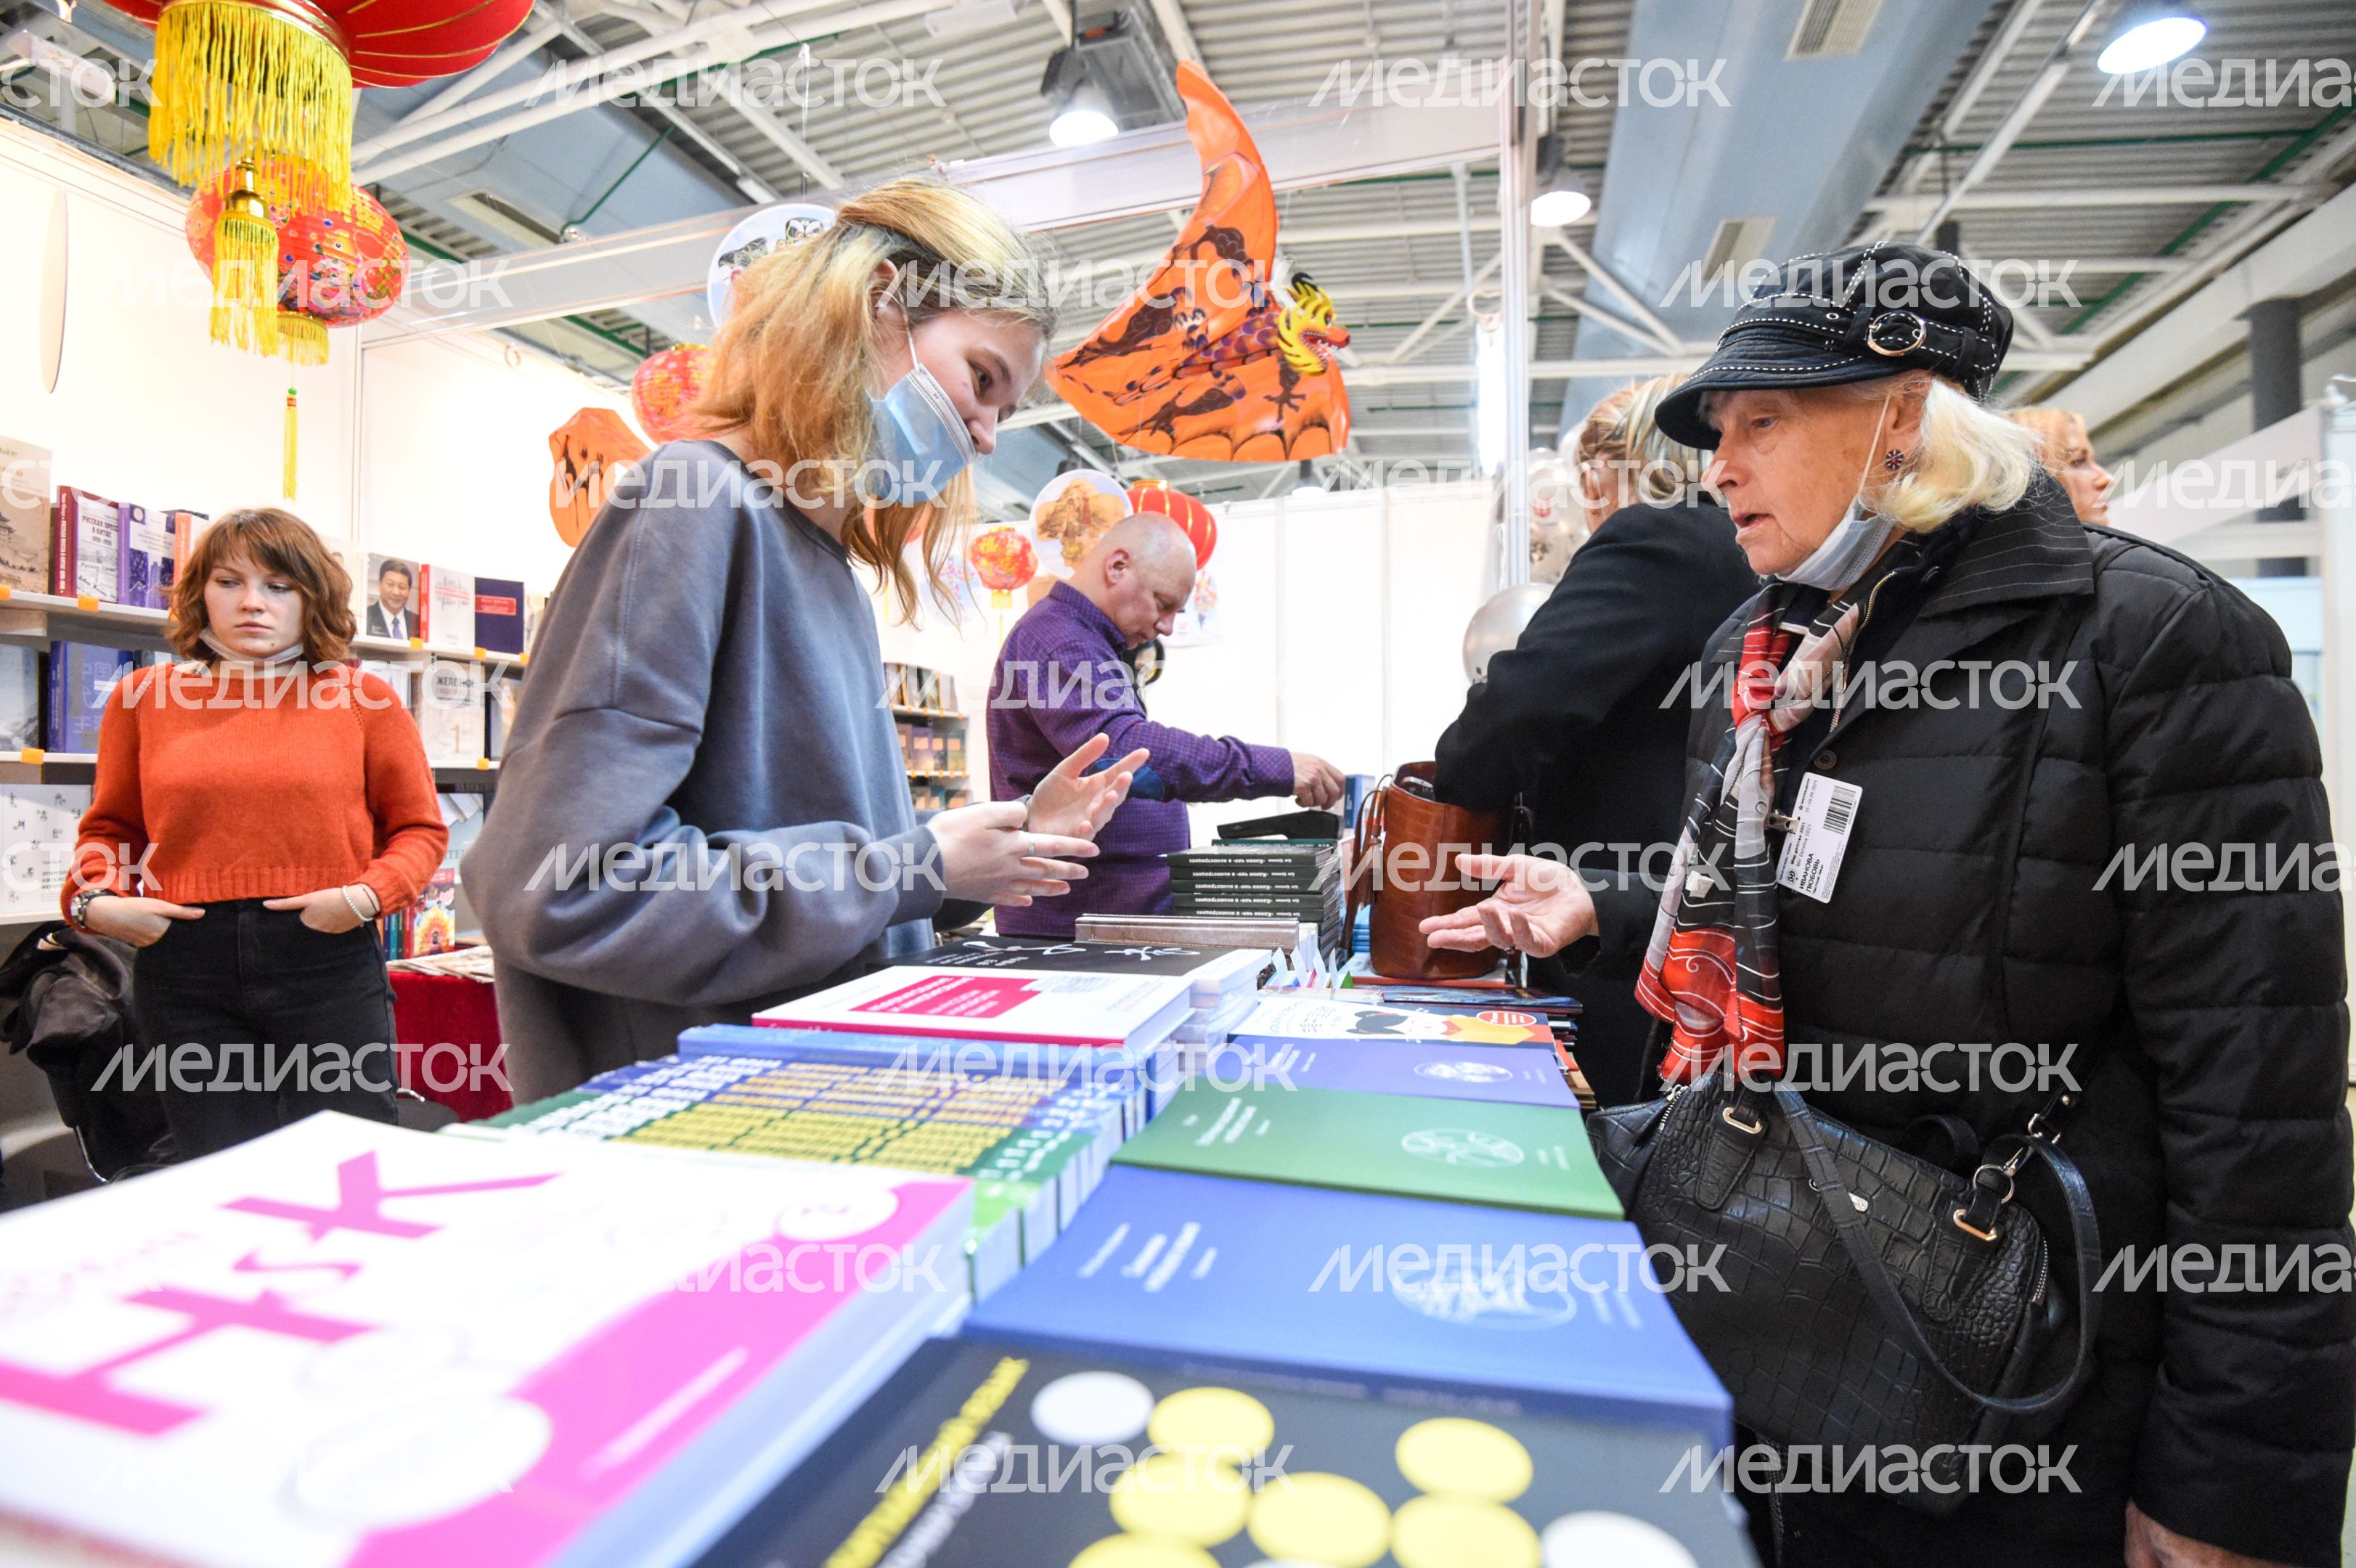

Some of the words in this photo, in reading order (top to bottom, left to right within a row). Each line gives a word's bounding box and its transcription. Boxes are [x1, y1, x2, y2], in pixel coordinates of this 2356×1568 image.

[105, 522, 118, 531] ПРЕСС
[1799, 853, 1814, 889] ИВАНОВА
[1806, 859, 1820, 893] ЛЮБОВЬ
